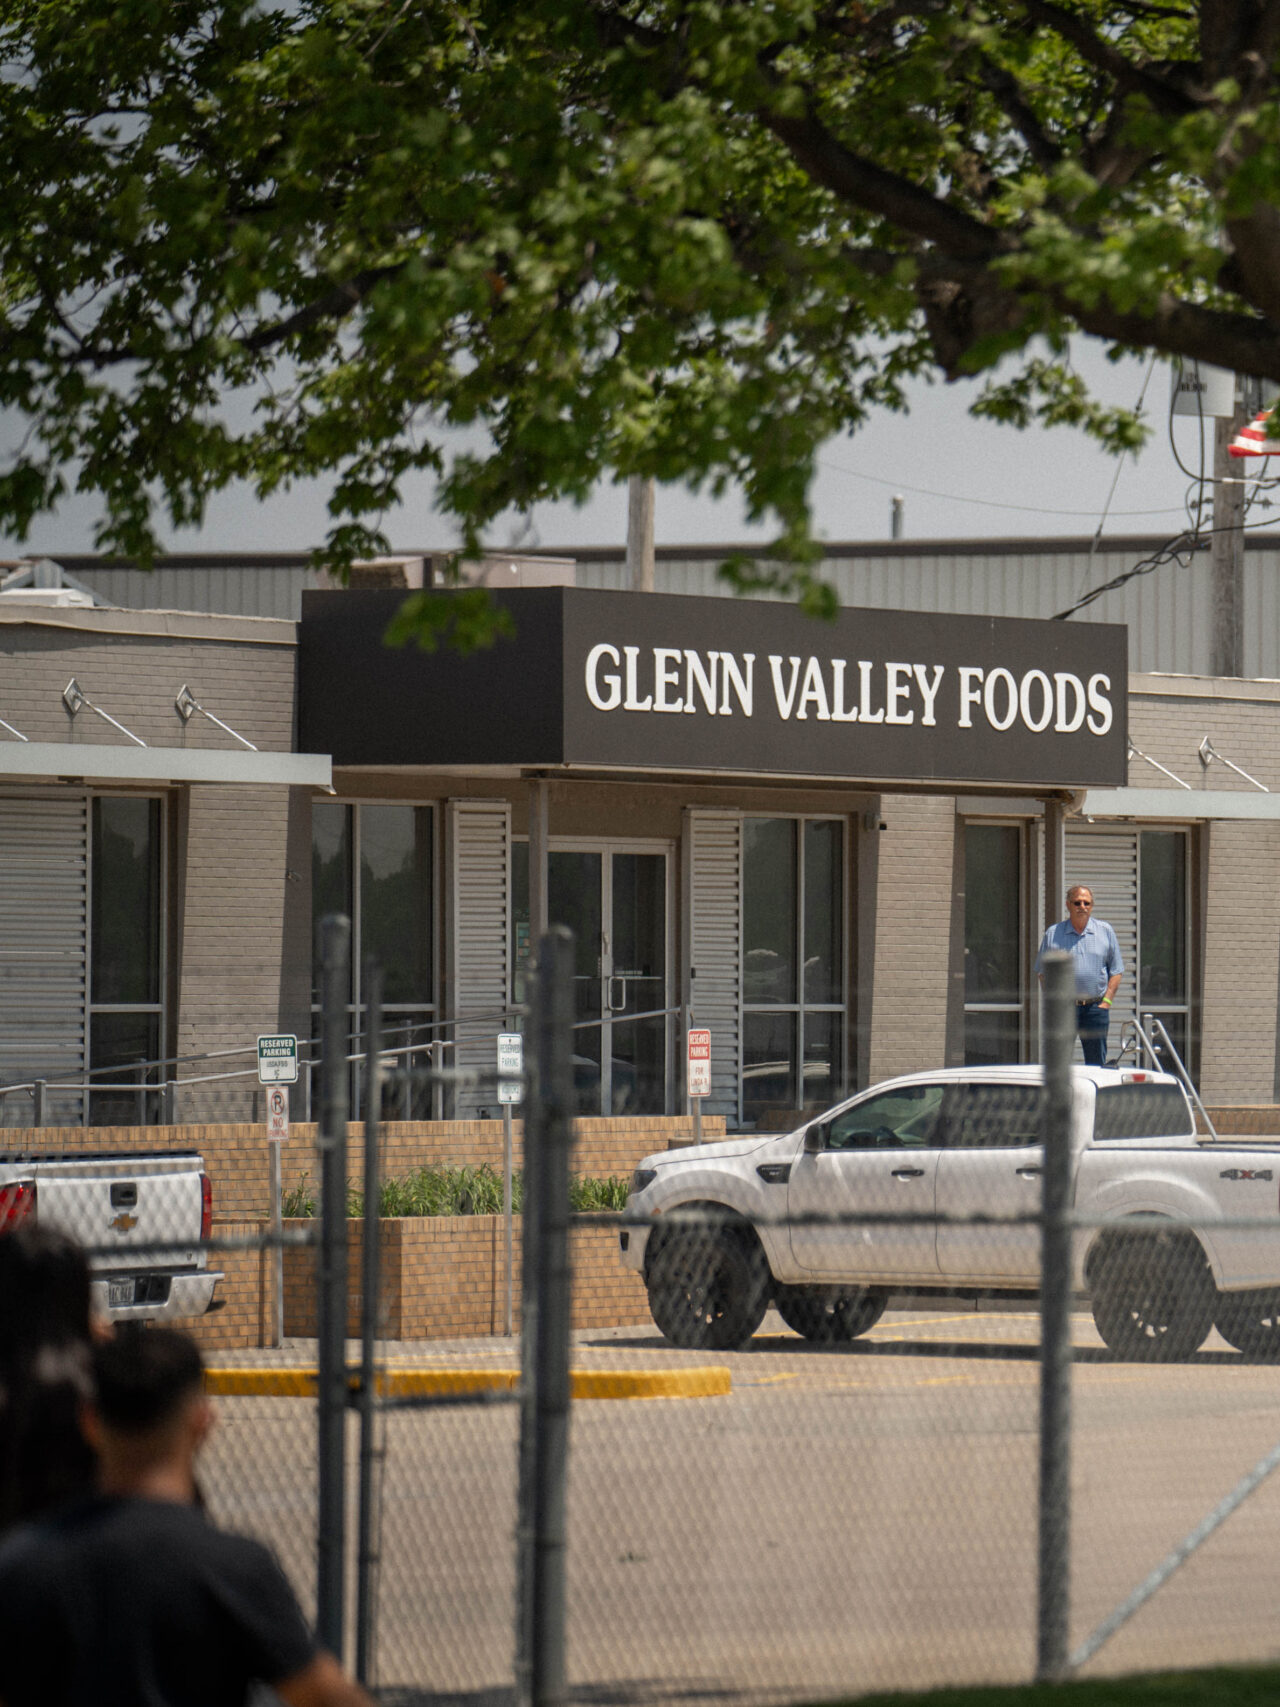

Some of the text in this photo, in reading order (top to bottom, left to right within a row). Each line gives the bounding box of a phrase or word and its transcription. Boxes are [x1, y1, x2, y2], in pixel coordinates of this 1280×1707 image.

[585, 643, 1113, 735] GLENN VALLEY FOODS
[260, 1039, 294, 1048] RESERVED
[690, 1033, 709, 1044] RESERVED
[262, 1048, 291, 1056] PARKING
[500, 1044, 521, 1053] RESERVED
[690, 1046, 708, 1057] PARKING
[272, 1117, 284, 1128] NO
